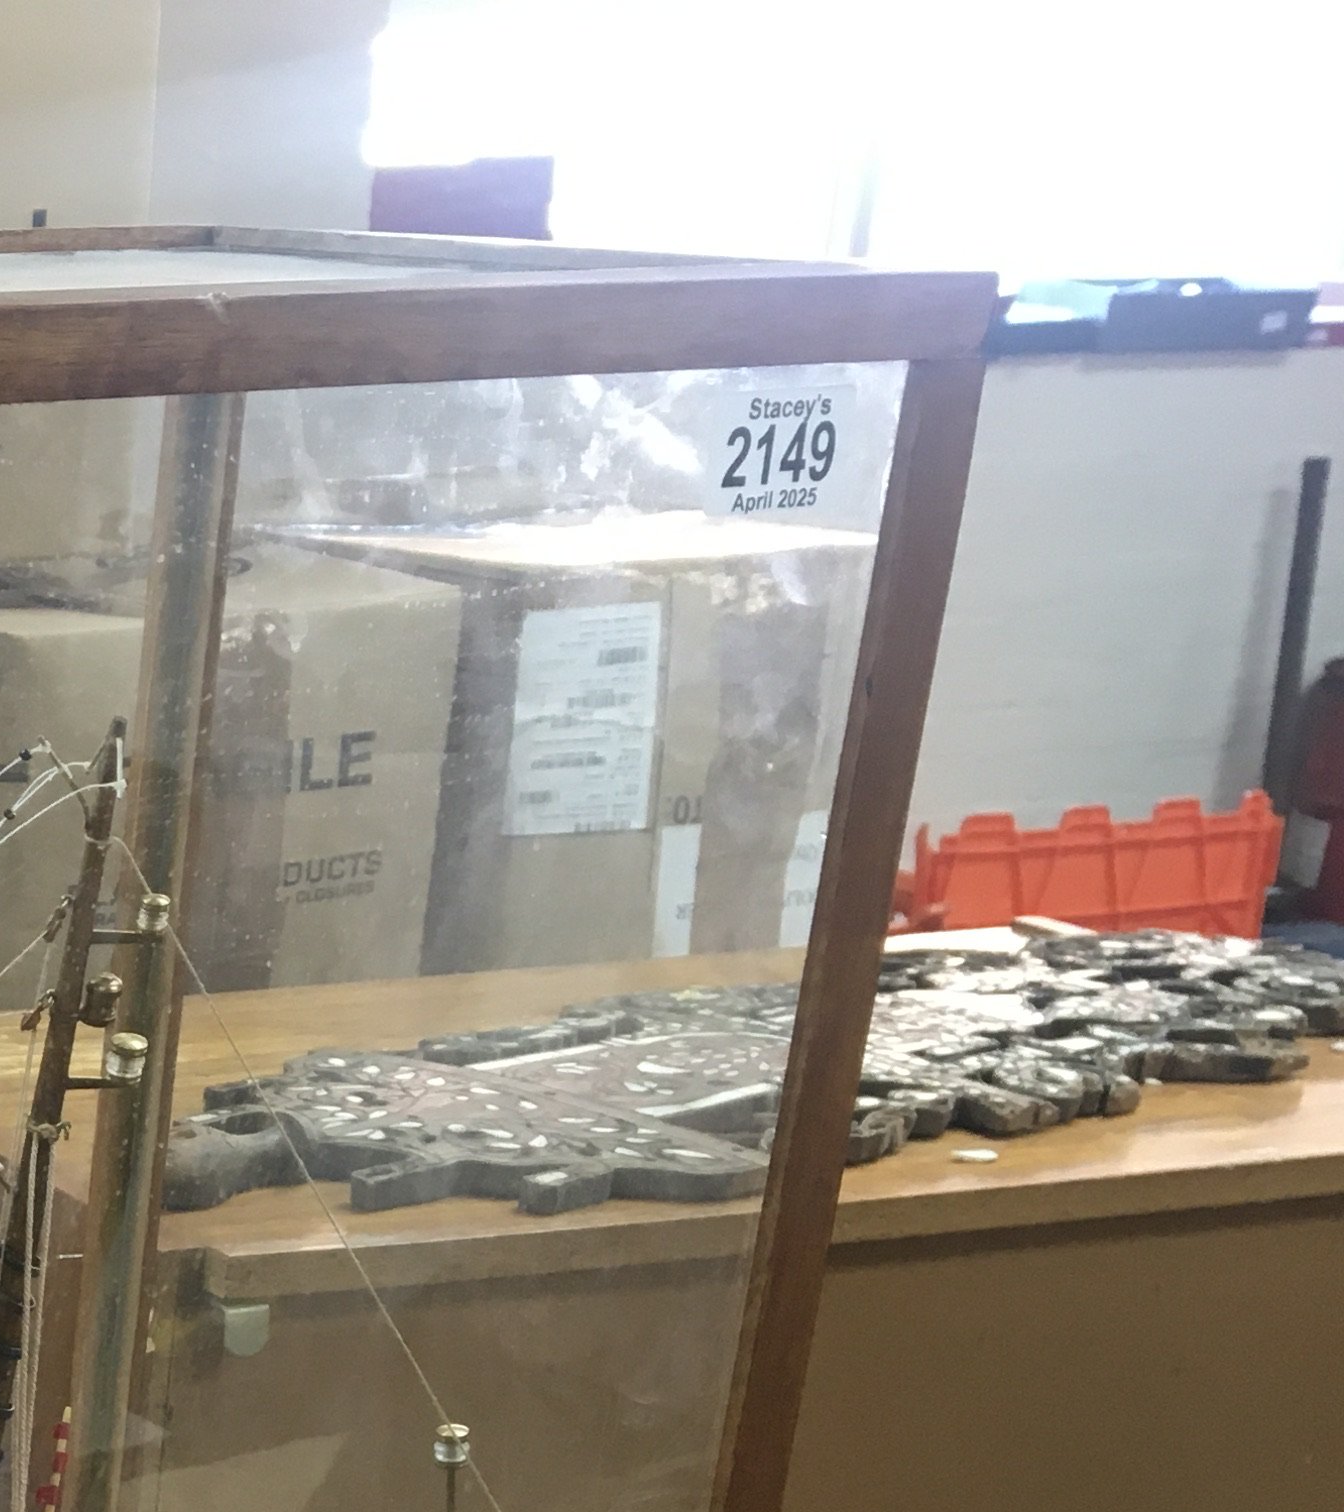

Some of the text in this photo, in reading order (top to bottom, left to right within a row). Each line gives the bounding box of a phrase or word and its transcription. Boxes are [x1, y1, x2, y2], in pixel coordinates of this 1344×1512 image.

[748, 394, 832, 422] Stacey's
[721, 420, 836, 488] 2149
[731, 487, 817, 514] April 2025
